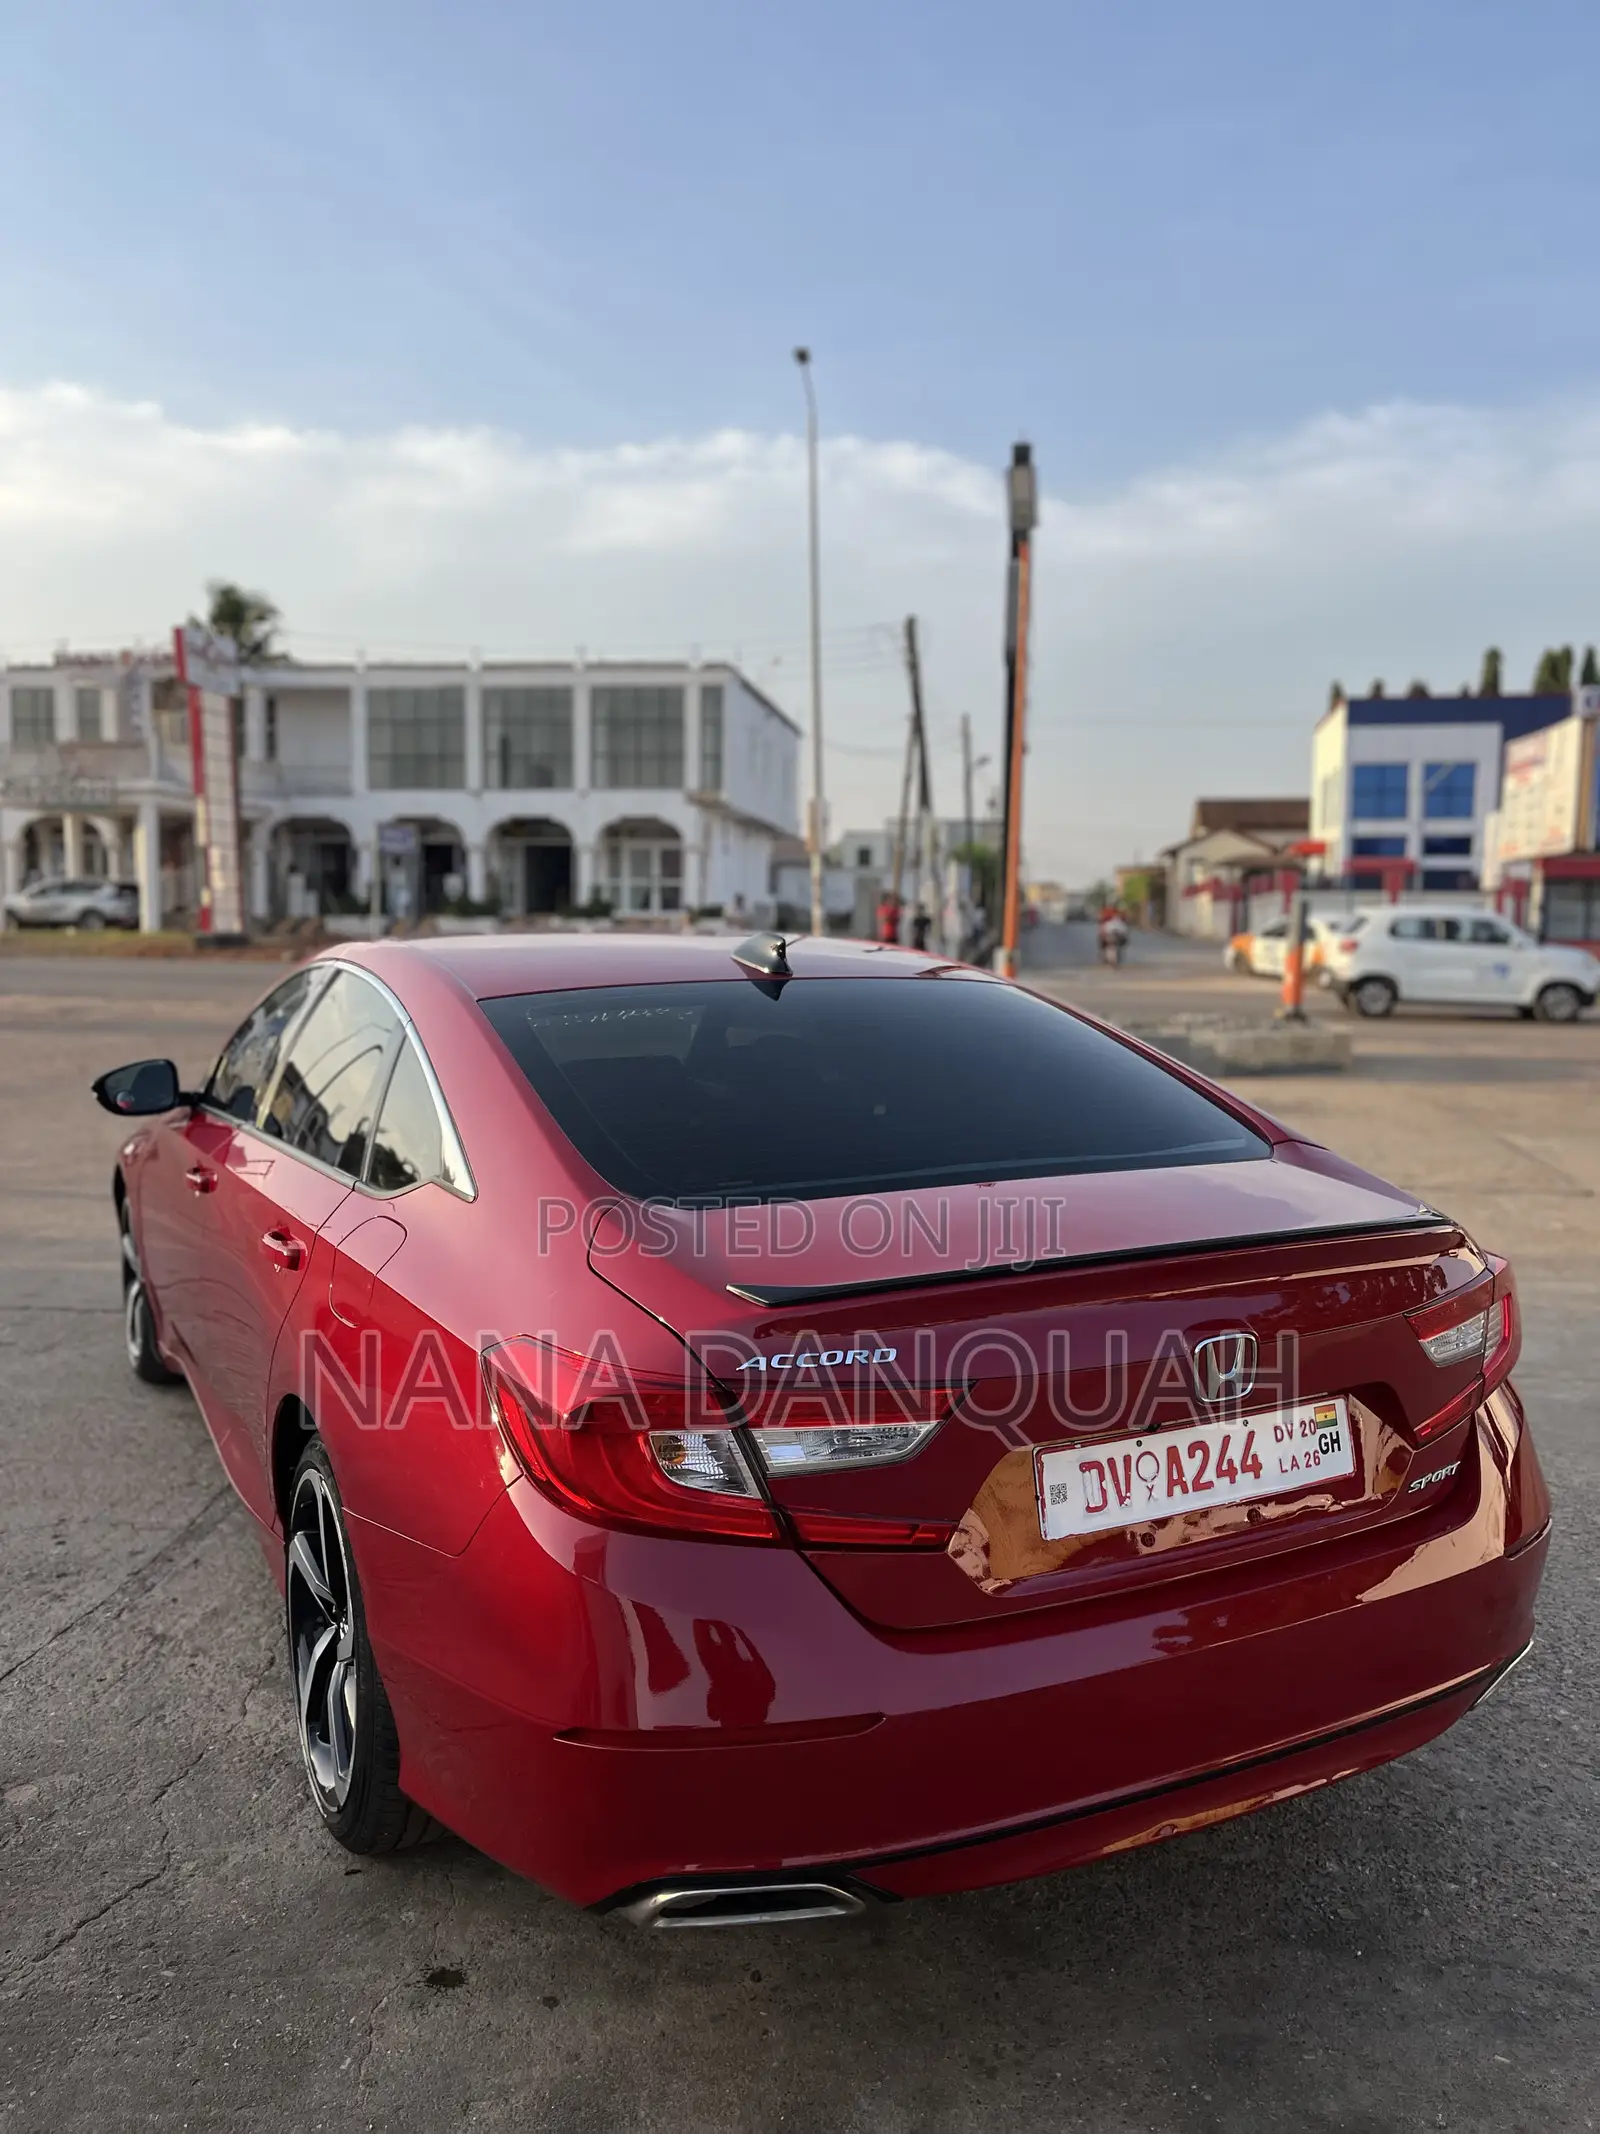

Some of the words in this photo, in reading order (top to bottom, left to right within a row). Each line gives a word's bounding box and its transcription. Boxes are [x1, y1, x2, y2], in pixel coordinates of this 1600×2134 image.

[736, 1348, 897, 1371] ACCORD
[1273, 1423, 1295, 1444] DV
[1299, 1418, 1317, 1439] 20
[1318, 1431, 1342, 1455] GH
[1166, 1430, 1263, 1498] A244
[1279, 1453, 1301, 1474] LA
[1304, 1450, 1321, 1469] 26
[1407, 1460, 1462, 1494] SPORT
